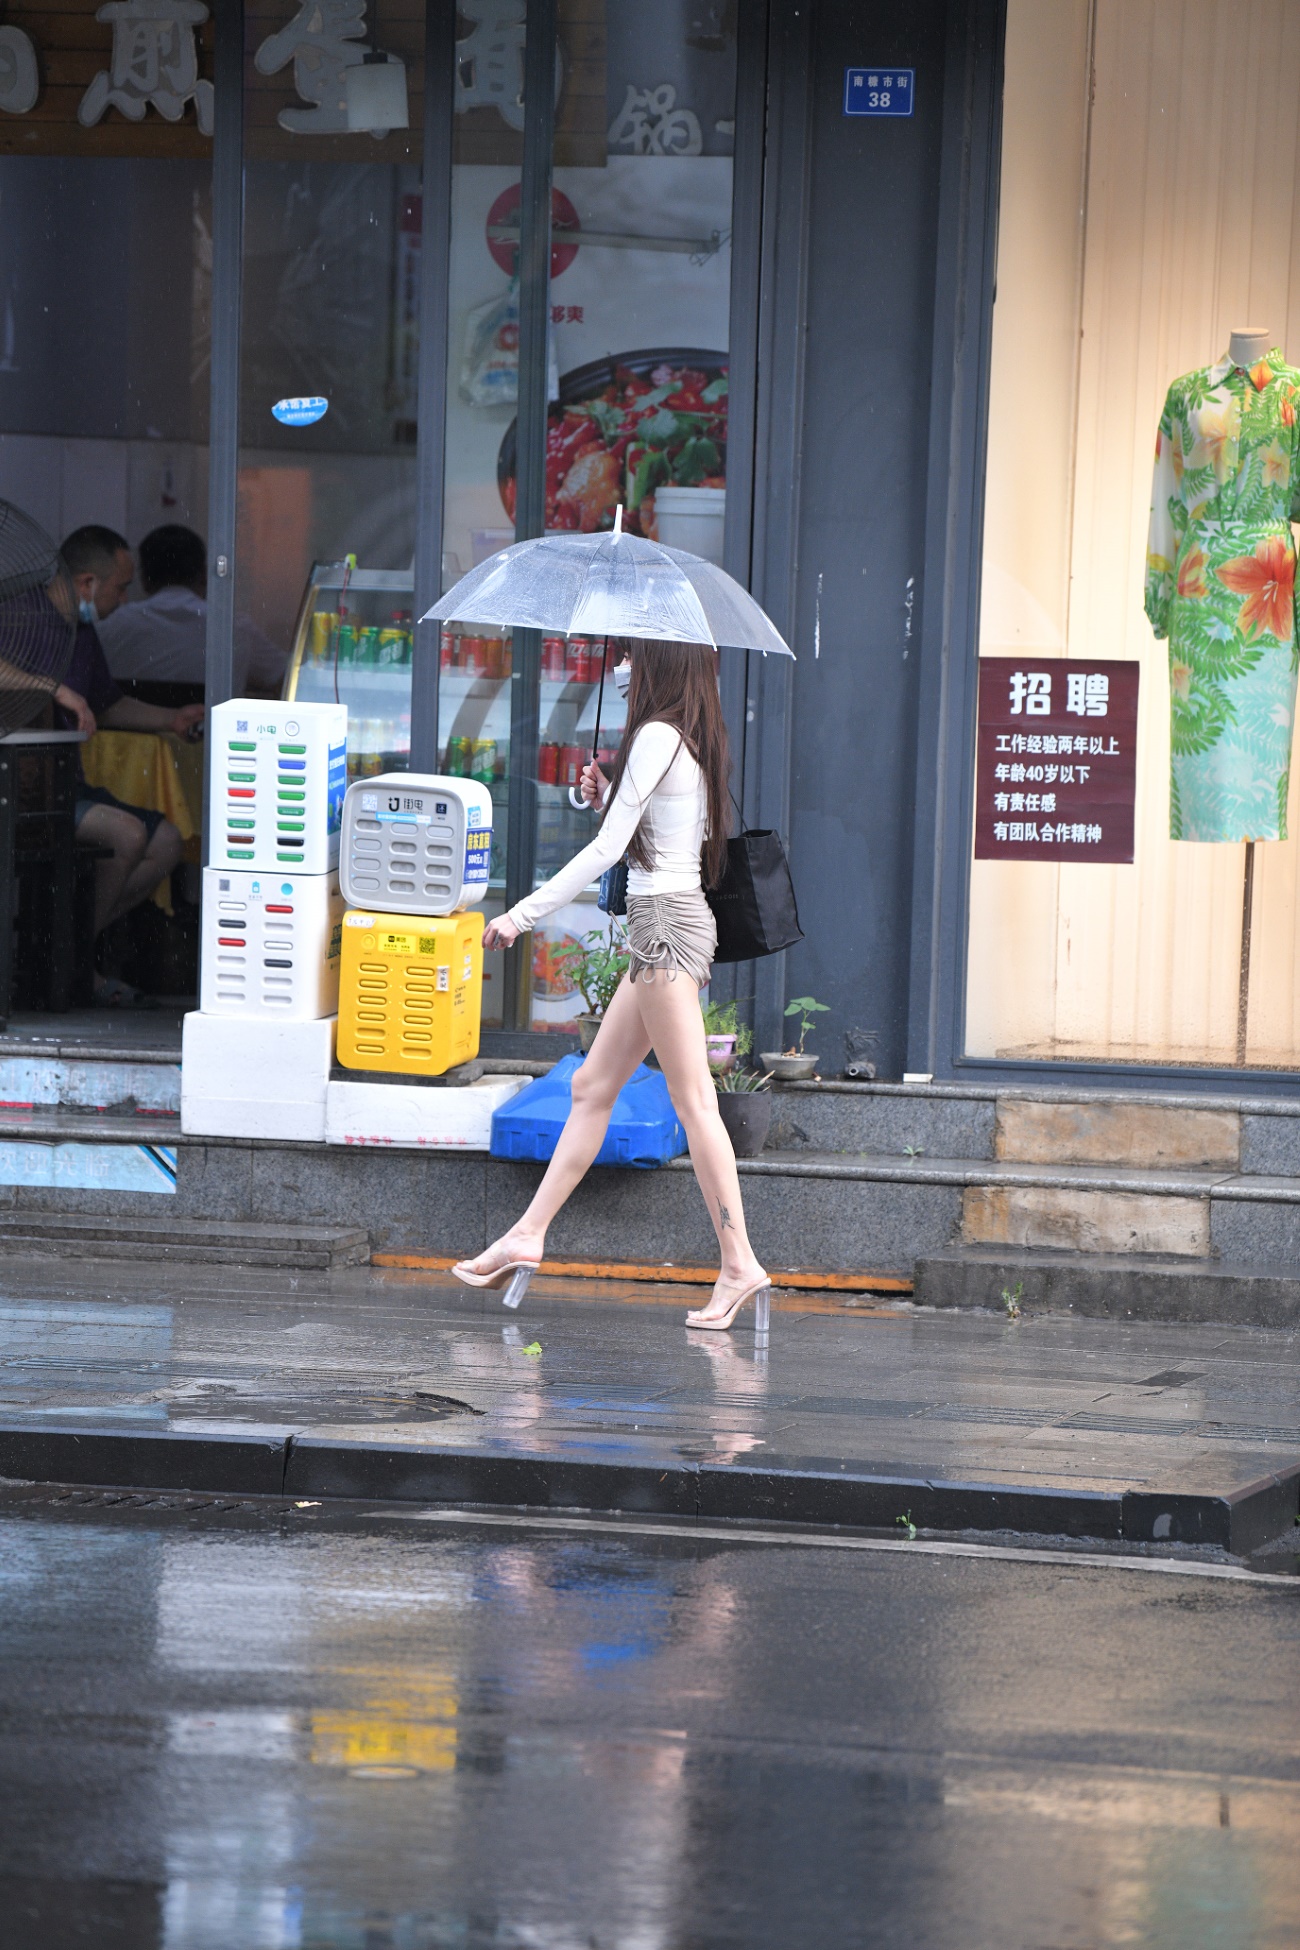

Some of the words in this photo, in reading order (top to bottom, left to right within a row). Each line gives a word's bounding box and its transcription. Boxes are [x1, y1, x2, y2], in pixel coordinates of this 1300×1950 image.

[868, 91, 891, 108] 38
[607, 83, 734, 156] 锅
[1009, 672, 1109, 717] 招聘
[256, 724, 277, 735] 小电
[995, 734, 1120, 755] 工作经验两年以上
[994, 762, 1091, 784] 年龄40岁以下
[403, 798, 423, 811] 街电
[994, 791, 1057, 812] 有责任感
[993, 820, 1102, 843] 有团队合作精神
